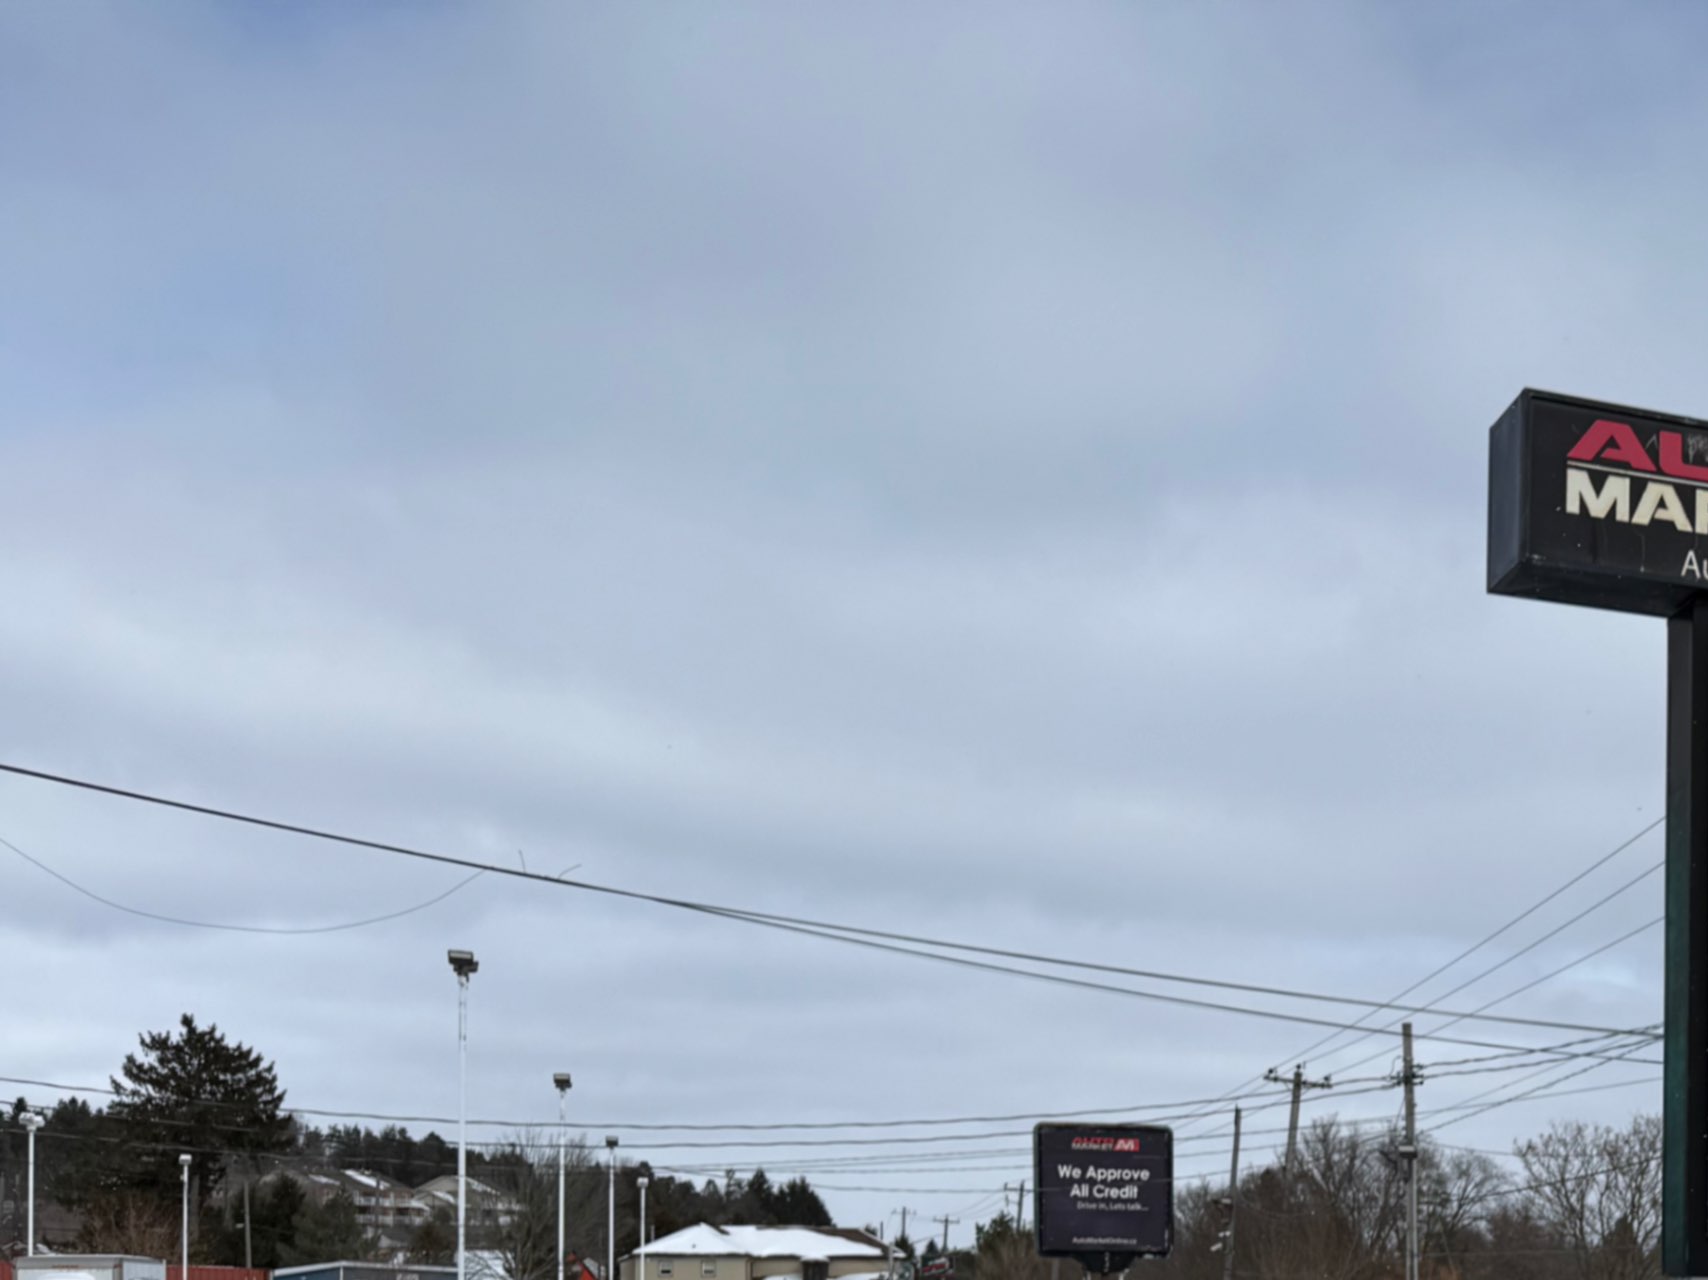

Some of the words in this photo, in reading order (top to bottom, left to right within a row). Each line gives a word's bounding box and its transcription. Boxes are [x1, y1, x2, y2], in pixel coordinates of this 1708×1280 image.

[1057, 1164, 1082, 1179] We
[1086, 1165, 1151, 1183] Approve
[1069, 1183, 1089, 1198] All
[1093, 1184, 1139, 1199] Credit
